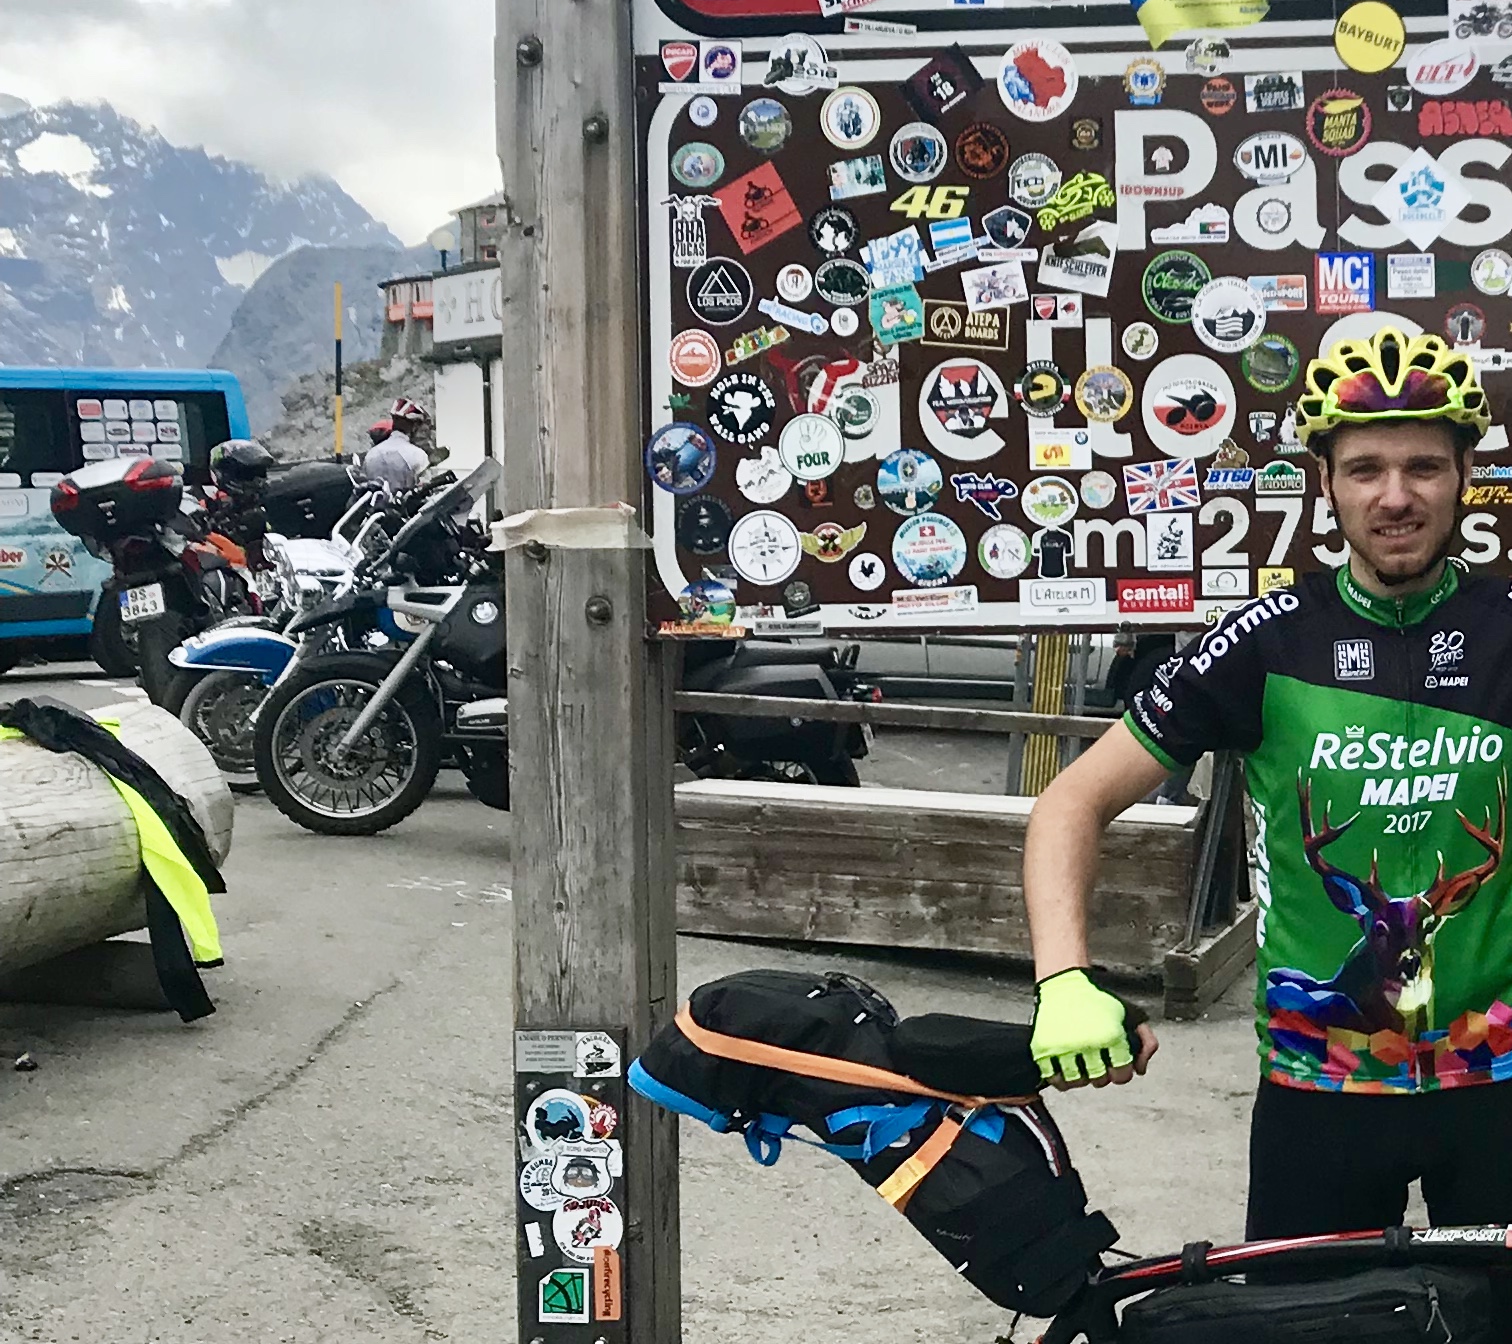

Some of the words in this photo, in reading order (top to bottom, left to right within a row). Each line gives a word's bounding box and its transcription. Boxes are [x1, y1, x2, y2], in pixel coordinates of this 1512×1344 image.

[1338, 19, 1400, 53] BAYBURT
[1254, 145, 1287, 169] MI
[890, 185, 970, 219] 46
[1318, 256, 1370, 293] MCi
[697, 295, 715, 307] LOS
[715, 295, 742, 307] PICOS
[1318, 292, 1370, 305] TOURS
[965, 311, 1000, 328] ATEPA
[964, 326, 1000, 340] BOARDS
[808, 316, 1237, 463] dello
[796, 451, 831, 470] FOUR
[1257, 473, 1302, 482] CALABRIA
[1257, 480, 1302, 490] ENDURO
[1073, 518, 1147, 568] m
[1197, 496, 1350, 567] 275
[1122, 582, 1189, 601] cantal!
[1347, 583, 1373, 610] MAPEI
[122, 600, 159, 619] 3843
[1188, 590, 1300, 676] bormio
[1429, 630, 1465, 655] 80
[1439, 676, 1469, 688] MAPEI
[1359, 772, 1460, 807] MAPEI
[1383, 810, 1432, 835] 2017
